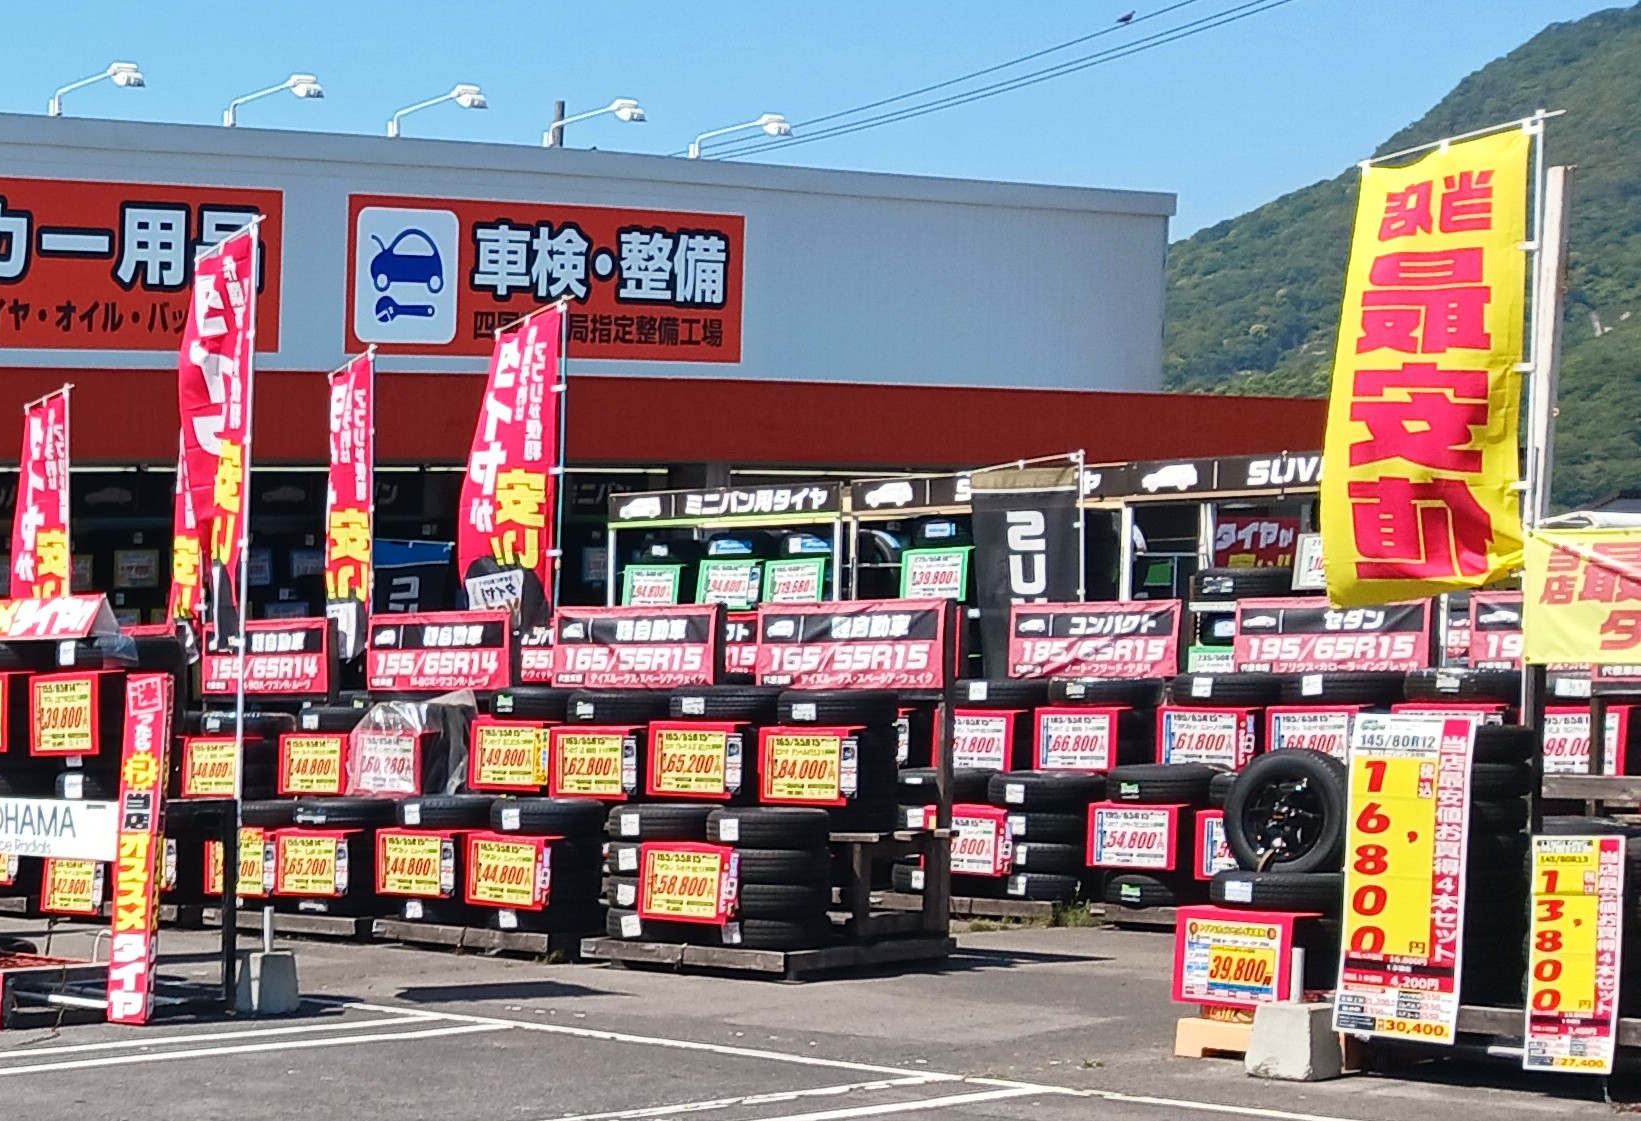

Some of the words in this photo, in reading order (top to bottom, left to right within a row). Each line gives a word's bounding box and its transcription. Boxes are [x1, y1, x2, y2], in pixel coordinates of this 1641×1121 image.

[474, 225, 726, 304] 車検・整備
[615, 619, 687, 641] 軽自動車
[831, 615, 911, 640] 軽自動車
[1069, 614, 1156, 635] コンパクト
[1323, 609, 1386, 631] セダン
[565, 646, 704, 671] 165/55R15
[1022, 639, 1167, 662] 185/65R15
[1249, 635, 1415, 661] 195/65R15
[376, 651, 498, 676] 155/65R14
[771, 645, 930, 673] 165/55R15
[1053, 735, 1099, 752] 66,800
[1176, 733, 1225, 751] 61,800
[1361, 733, 1436, 748] 145/80R12
[486, 748, 526, 768] 49,800
[667, 754, 713, 774] 65,200
[778, 759, 828, 780] 84,000
[1109, 831, 1158, 849] 54,800
[390, 857, 431, 876] 44,800
[482, 863, 525, 884] 44,800
[659, 875, 708, 897] 58,800
